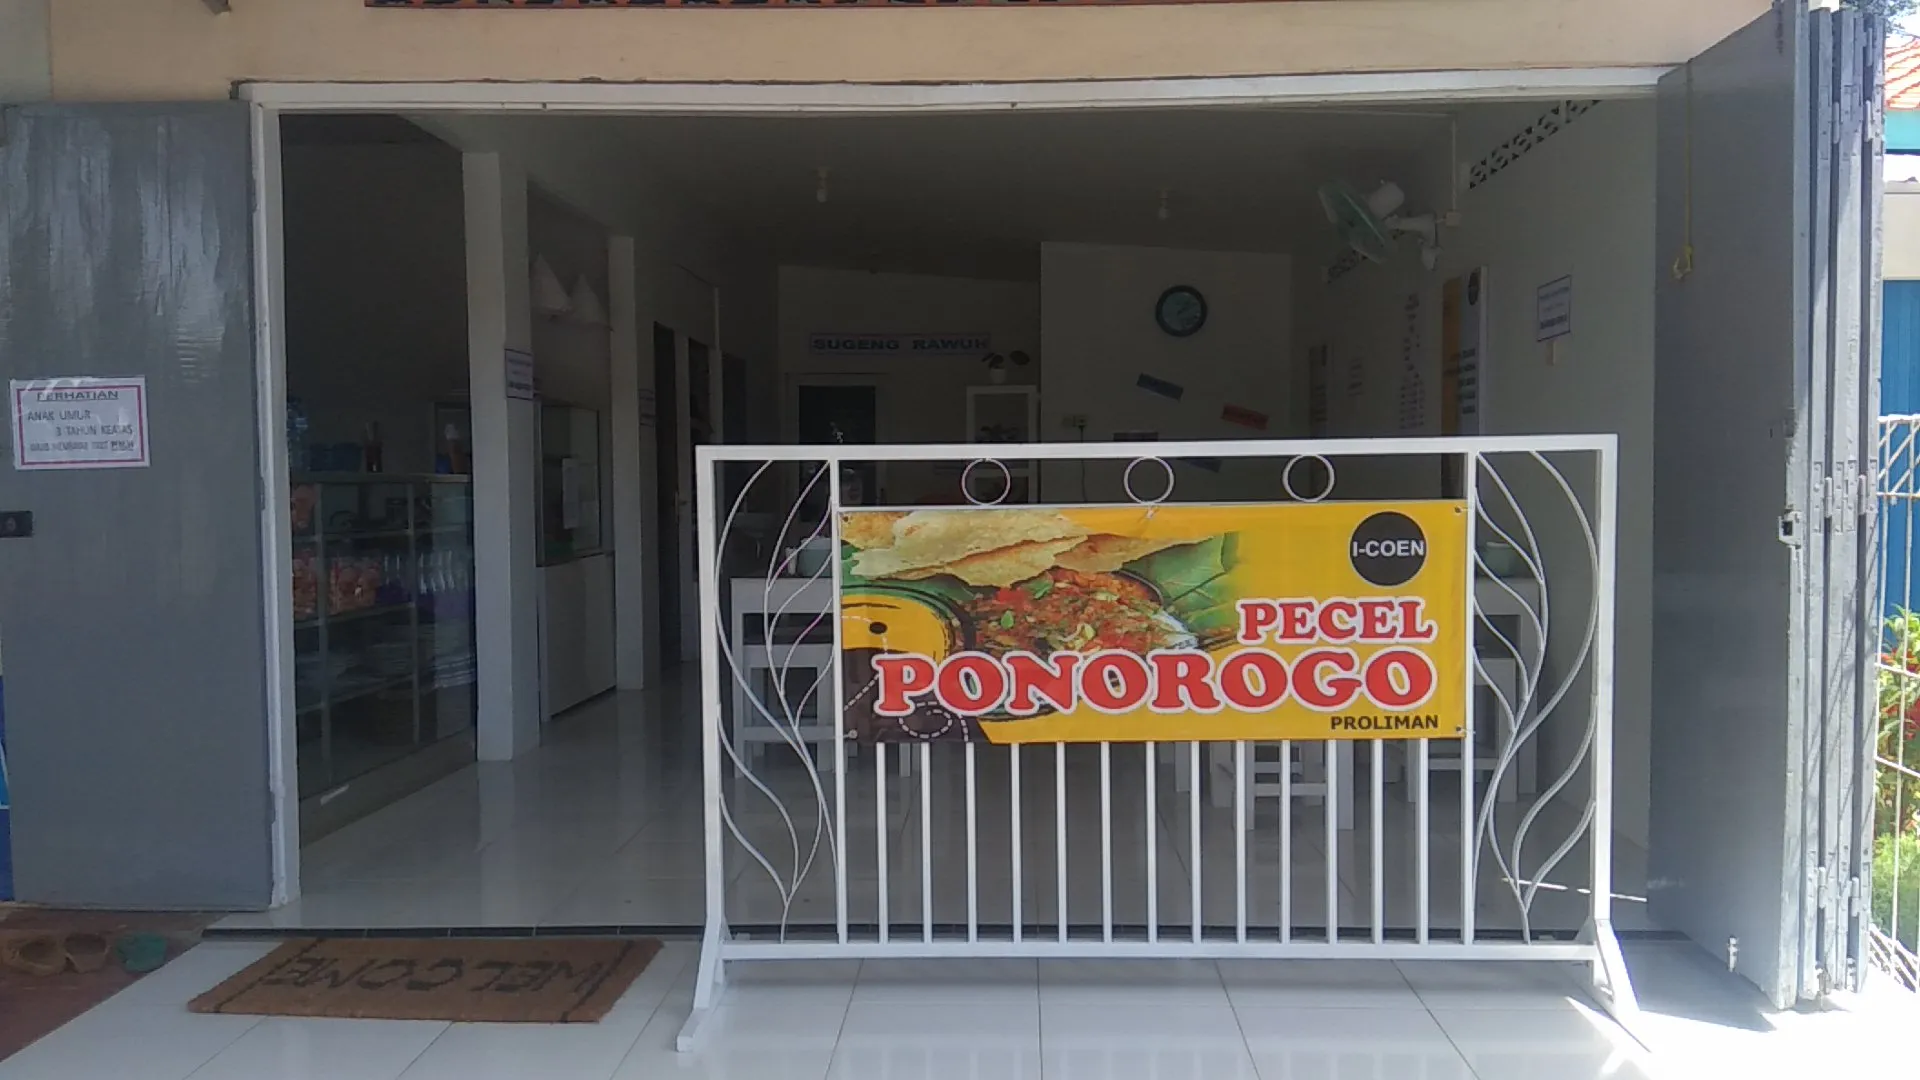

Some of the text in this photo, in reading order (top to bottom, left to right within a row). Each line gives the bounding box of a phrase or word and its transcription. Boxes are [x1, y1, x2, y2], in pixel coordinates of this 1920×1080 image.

[812, 337, 987, 351] SUGENG RAWUH
[28, 410, 55, 421] ANAK
[101, 424, 133, 436] KEAAS
[1352, 538, 1425, 558] I-COEN
[1238, 598, 1436, 643] PECEL
[873, 650, 1436, 715] PONOROGO
[1330, 714, 1439, 732] PROLIMAN
[262, 957, 603, 992] WELCOME
